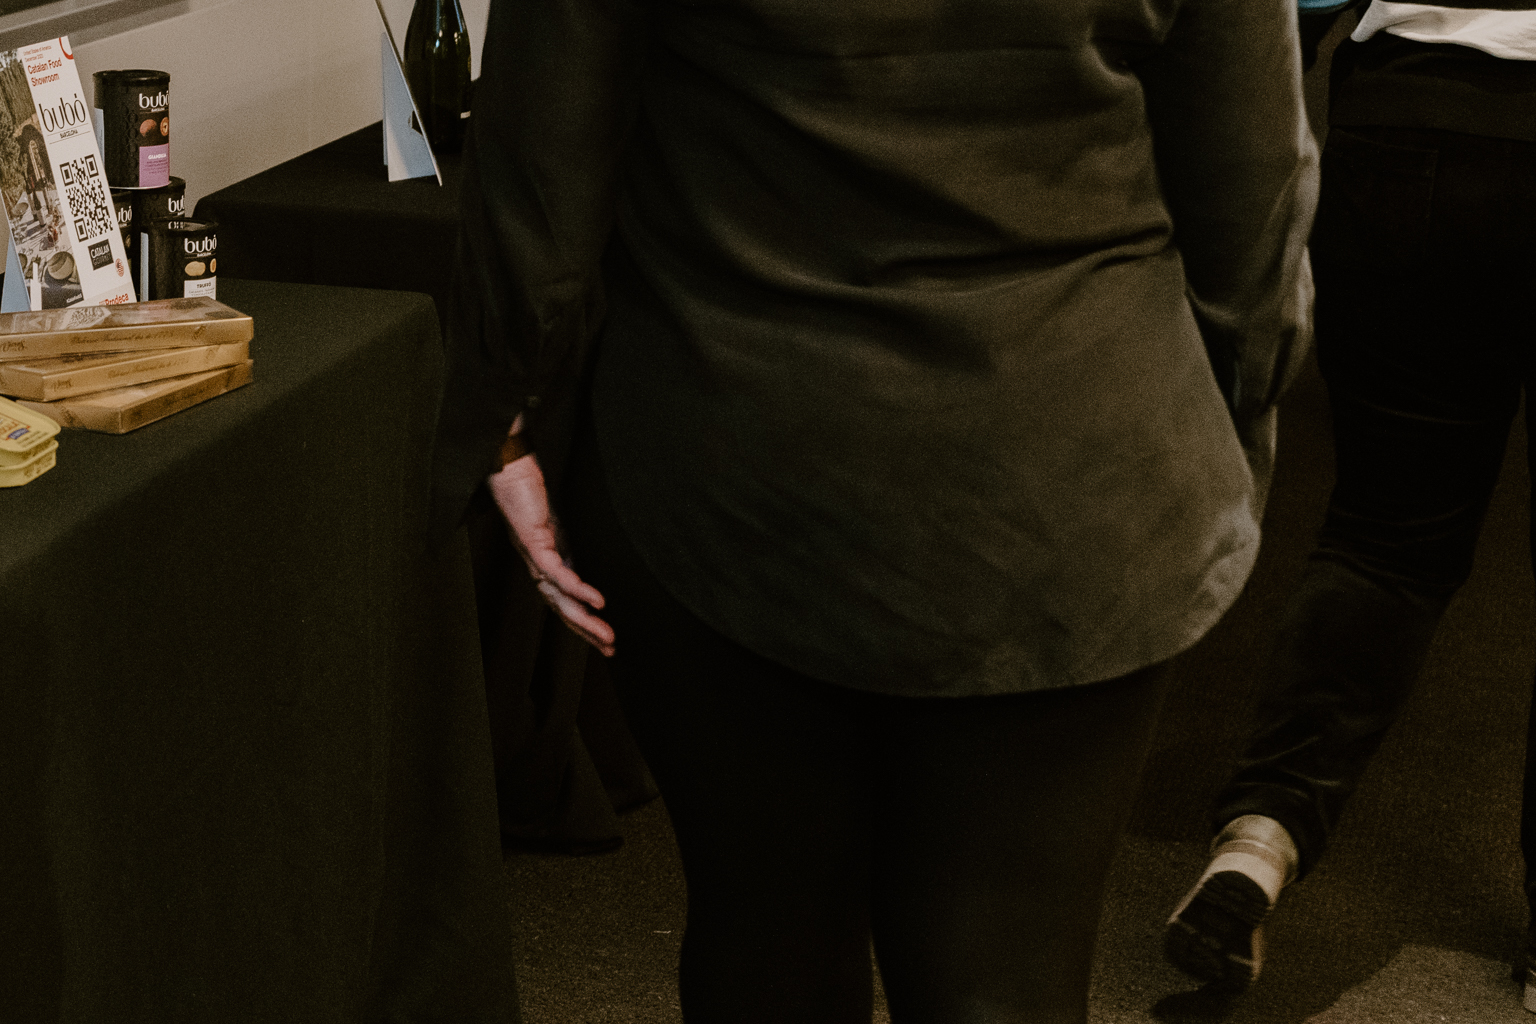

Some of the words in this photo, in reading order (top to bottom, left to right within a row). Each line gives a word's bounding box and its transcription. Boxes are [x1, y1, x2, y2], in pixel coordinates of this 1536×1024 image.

[27, 61, 48, 74] Catalan
[49, 57, 63, 69] Food
[30, 73, 60, 87] Showroom
[184, 234, 217, 254] bubó
